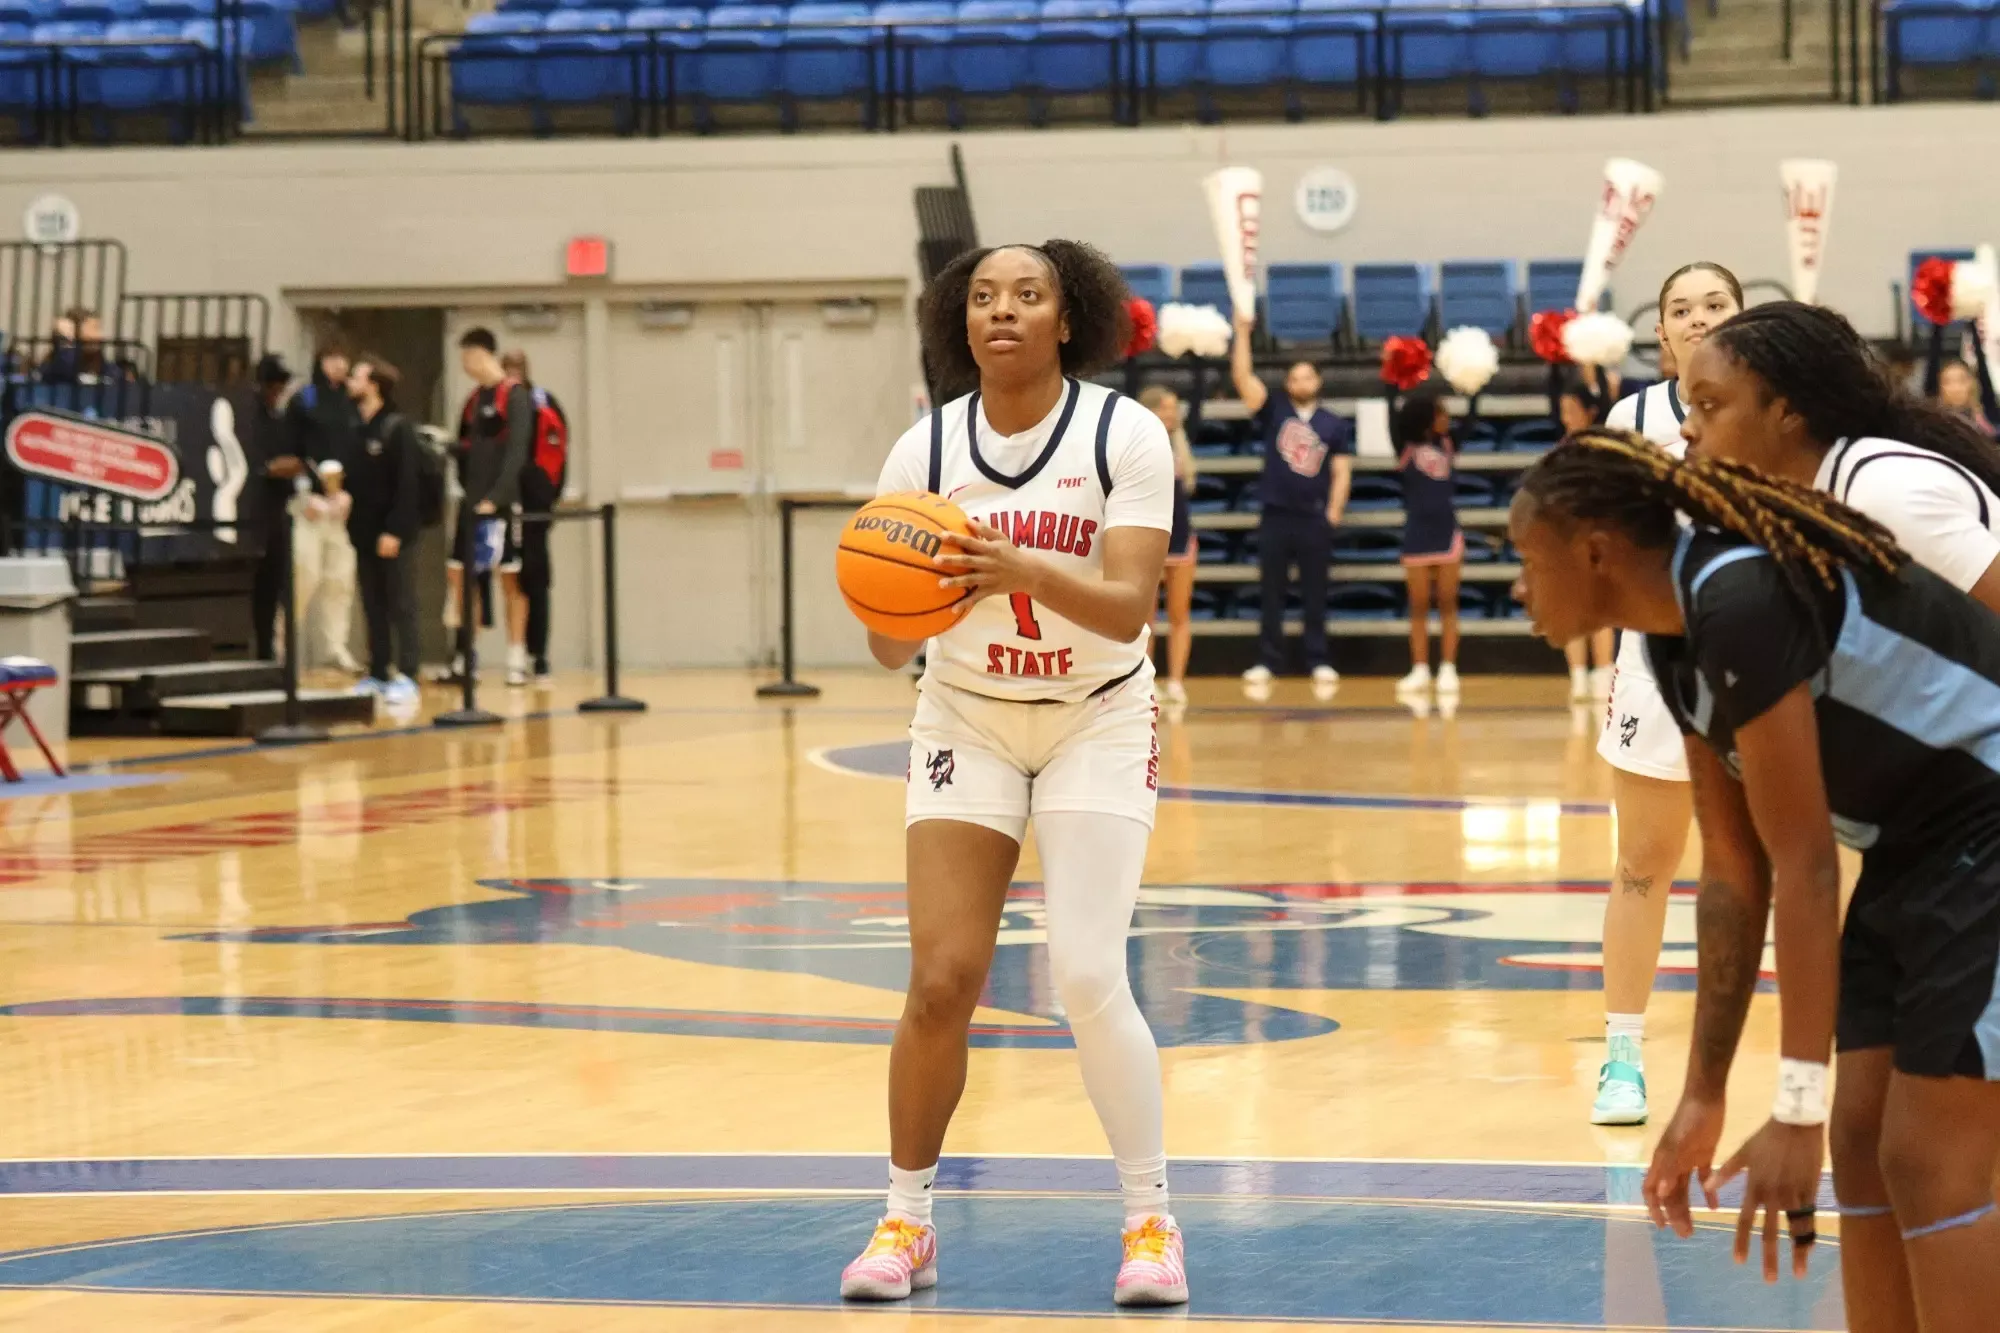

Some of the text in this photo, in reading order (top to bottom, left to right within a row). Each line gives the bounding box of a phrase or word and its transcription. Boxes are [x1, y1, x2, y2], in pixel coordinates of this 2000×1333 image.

[854, 516, 942, 559] Wilson
[972, 510, 1098, 557] UMBUS
[1008, 592, 1042, 641] 1
[987, 643, 1073, 676] STATE
